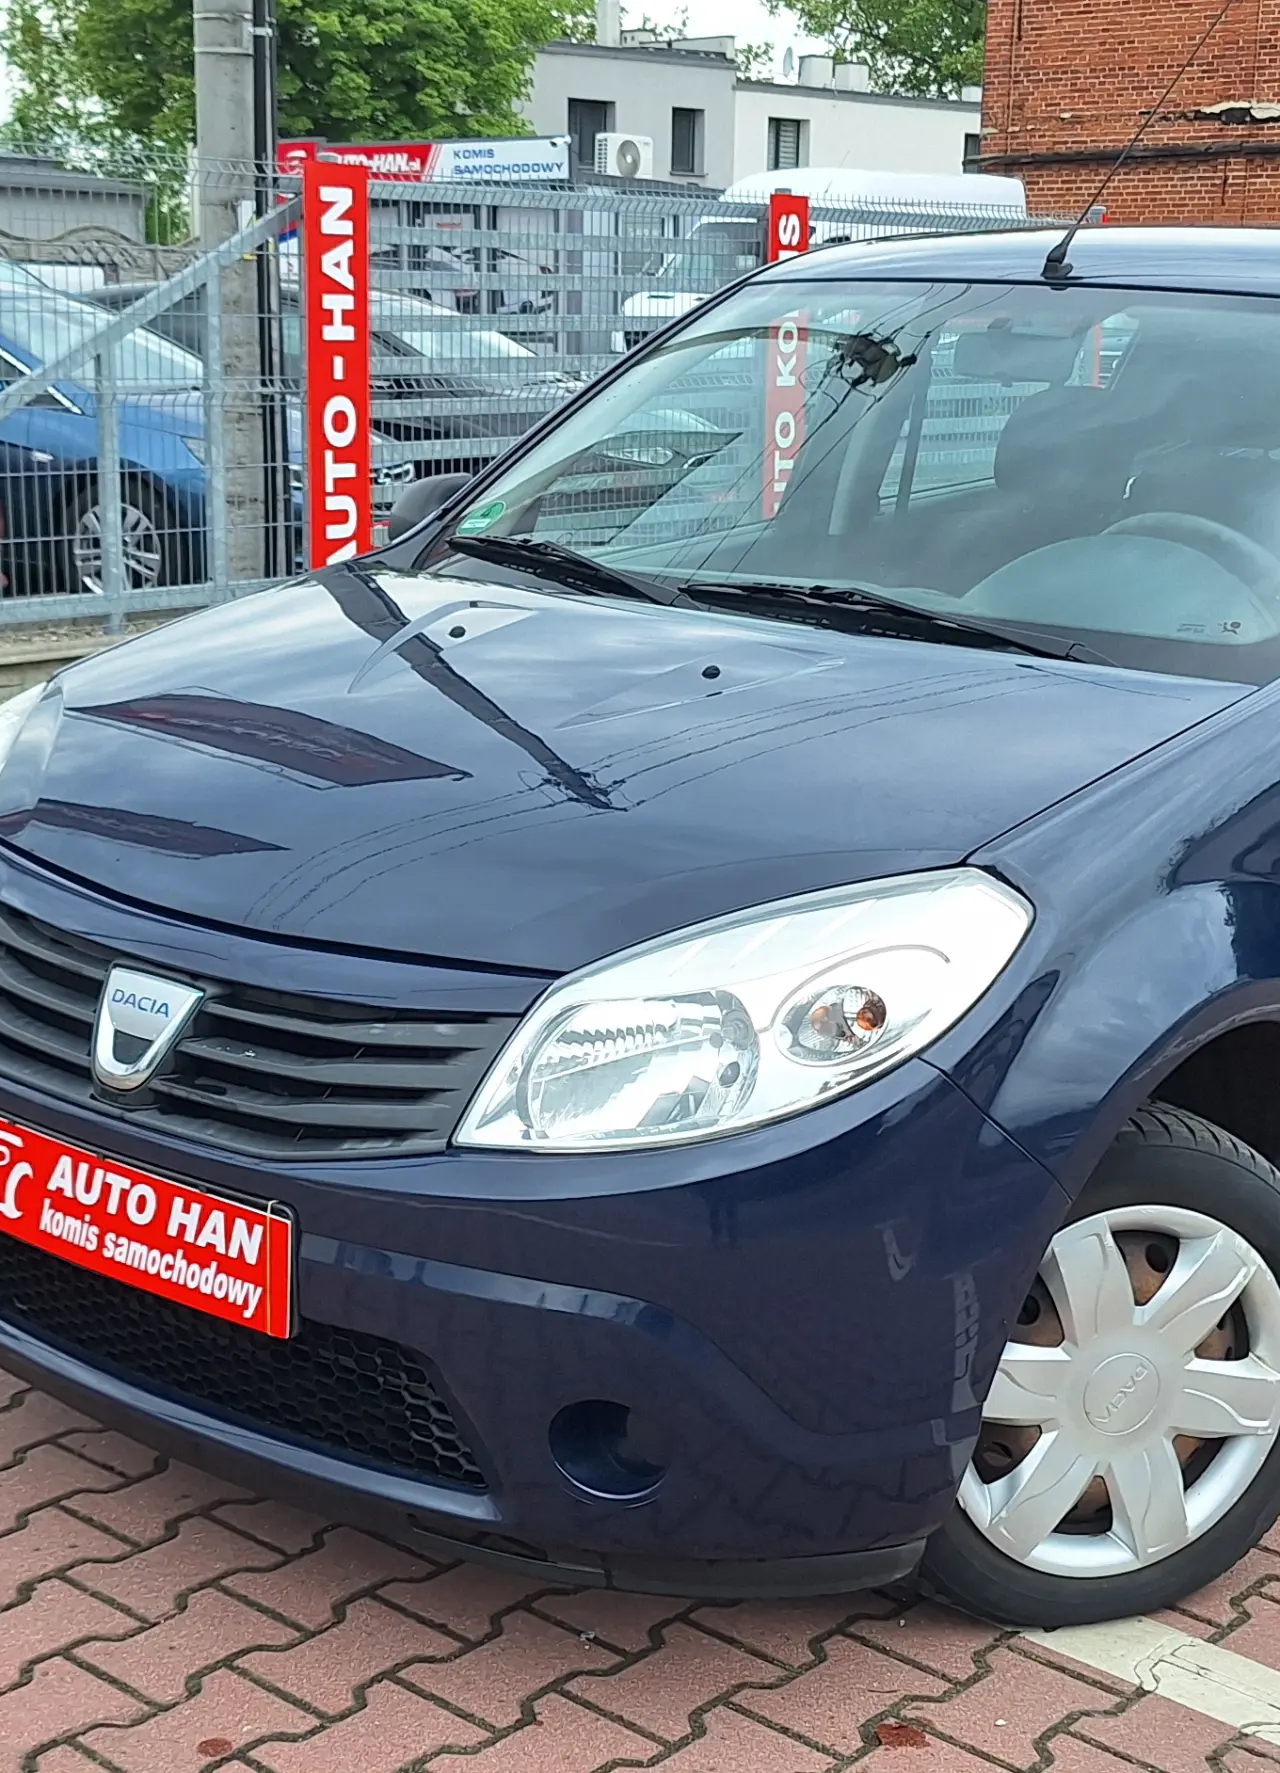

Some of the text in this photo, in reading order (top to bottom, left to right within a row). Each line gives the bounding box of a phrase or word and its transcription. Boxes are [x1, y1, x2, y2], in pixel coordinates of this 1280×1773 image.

[453, 148, 495, 160] KOMIS
[453, 162, 564, 175] SAMOCHODOWY
[111, 987, 170, 1019] DACIA
[46, 1153, 264, 1266] AUTO HAN
[39, 1198, 263, 1319] komis samochodowy
[1094, 1362, 1150, 1423] DACIA
